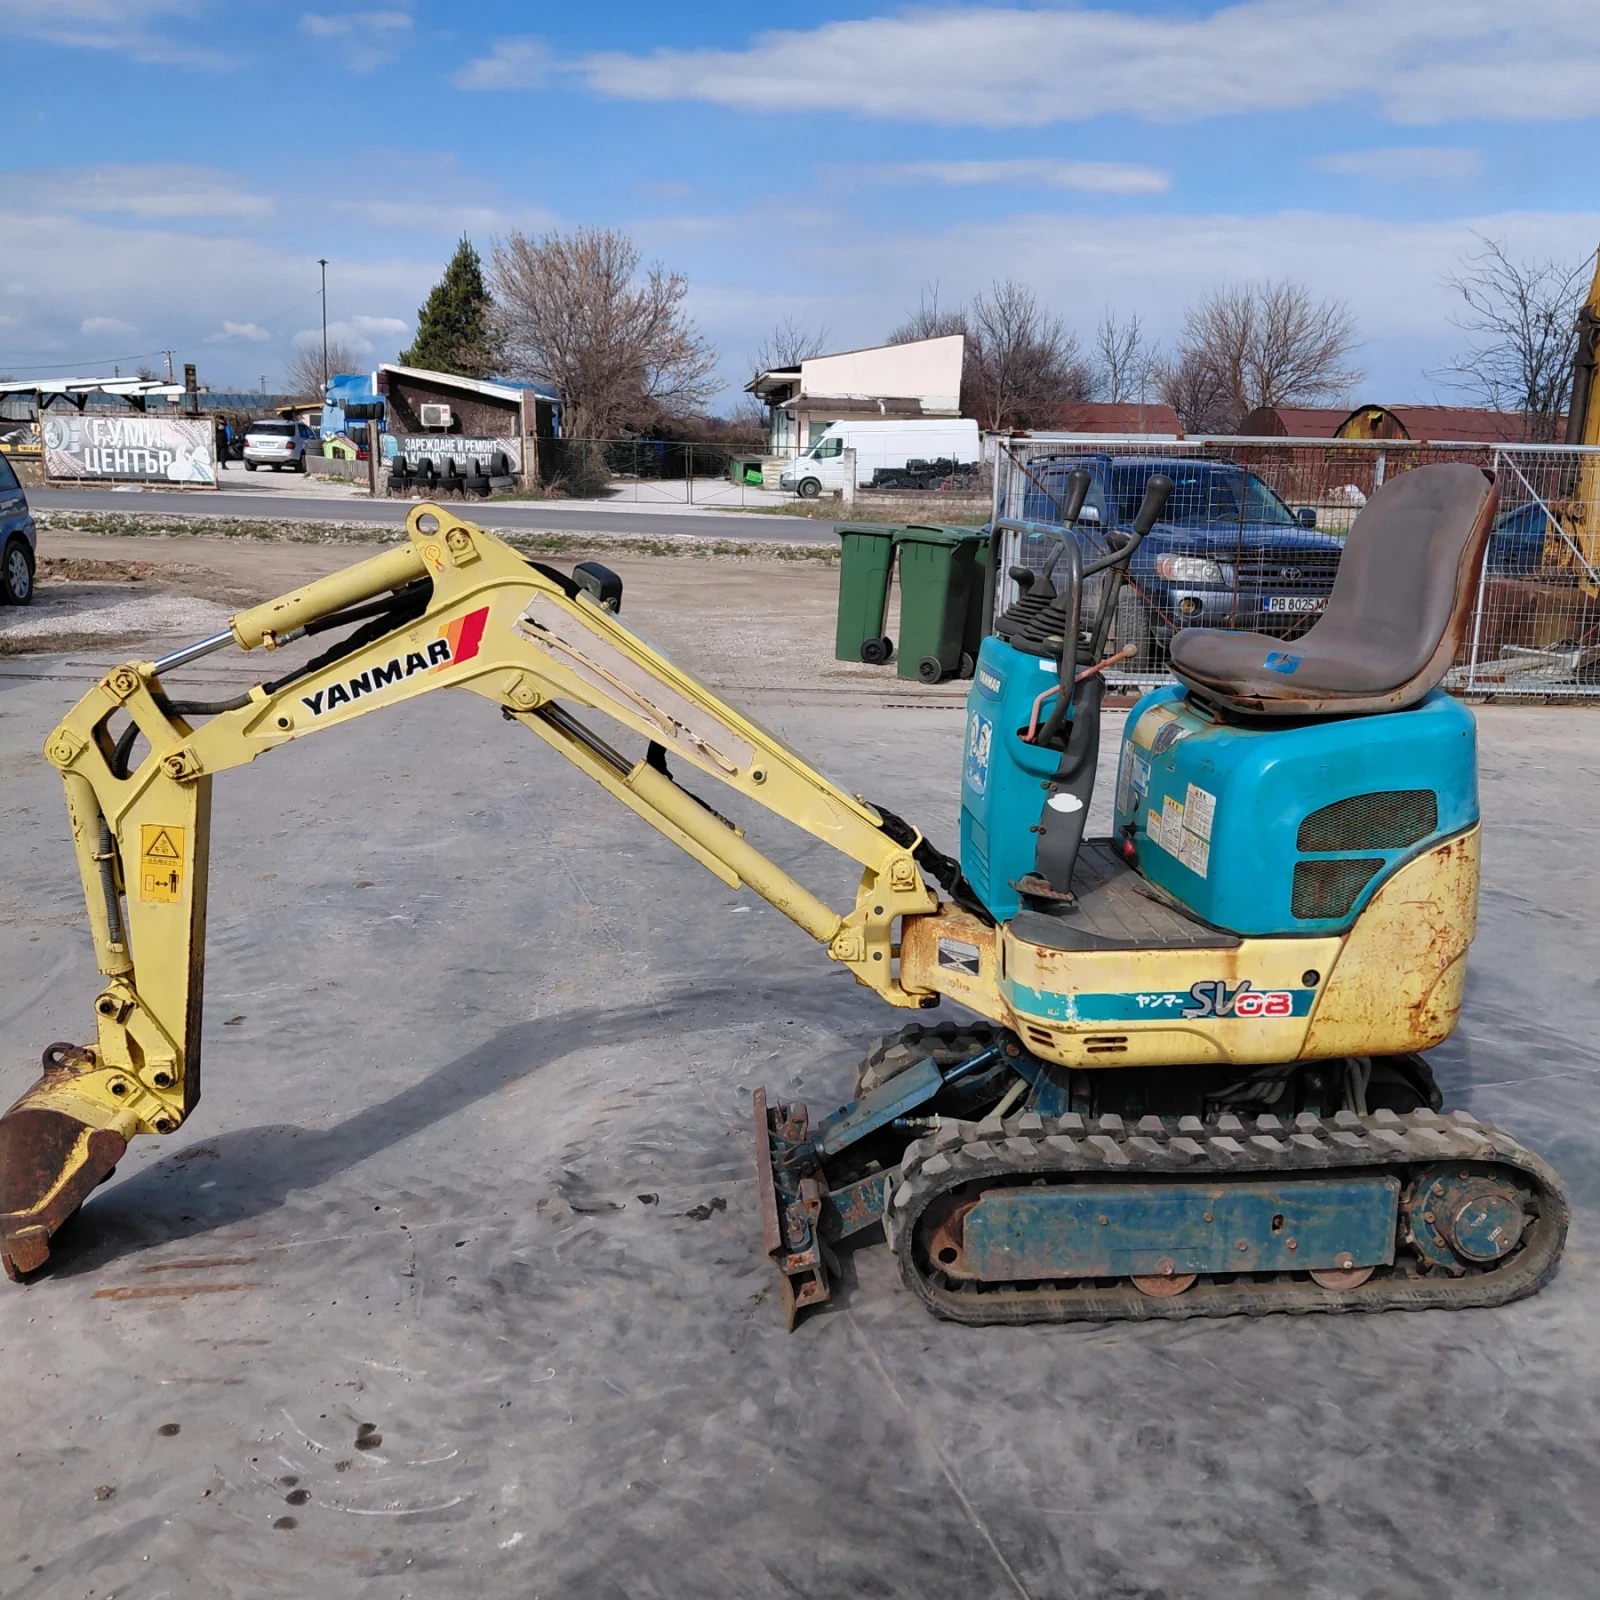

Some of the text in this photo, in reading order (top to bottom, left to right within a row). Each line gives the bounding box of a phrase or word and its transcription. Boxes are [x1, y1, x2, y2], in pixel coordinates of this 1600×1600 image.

[93, 420, 162, 447] ГУМИ
[405, 438, 497, 453] ЗАРЕЖДАНЕ И РЕМОНТ
[84, 447, 172, 475] ЦЕНТЪР
[1271, 598, 1286, 611] PB
[1288, 598, 1314, 611] 8025
[301, 638, 452, 716] YANMAR
[980, 668, 1001, 694] YANMAR
[1136, 993, 1184, 1008] ヤンマー
